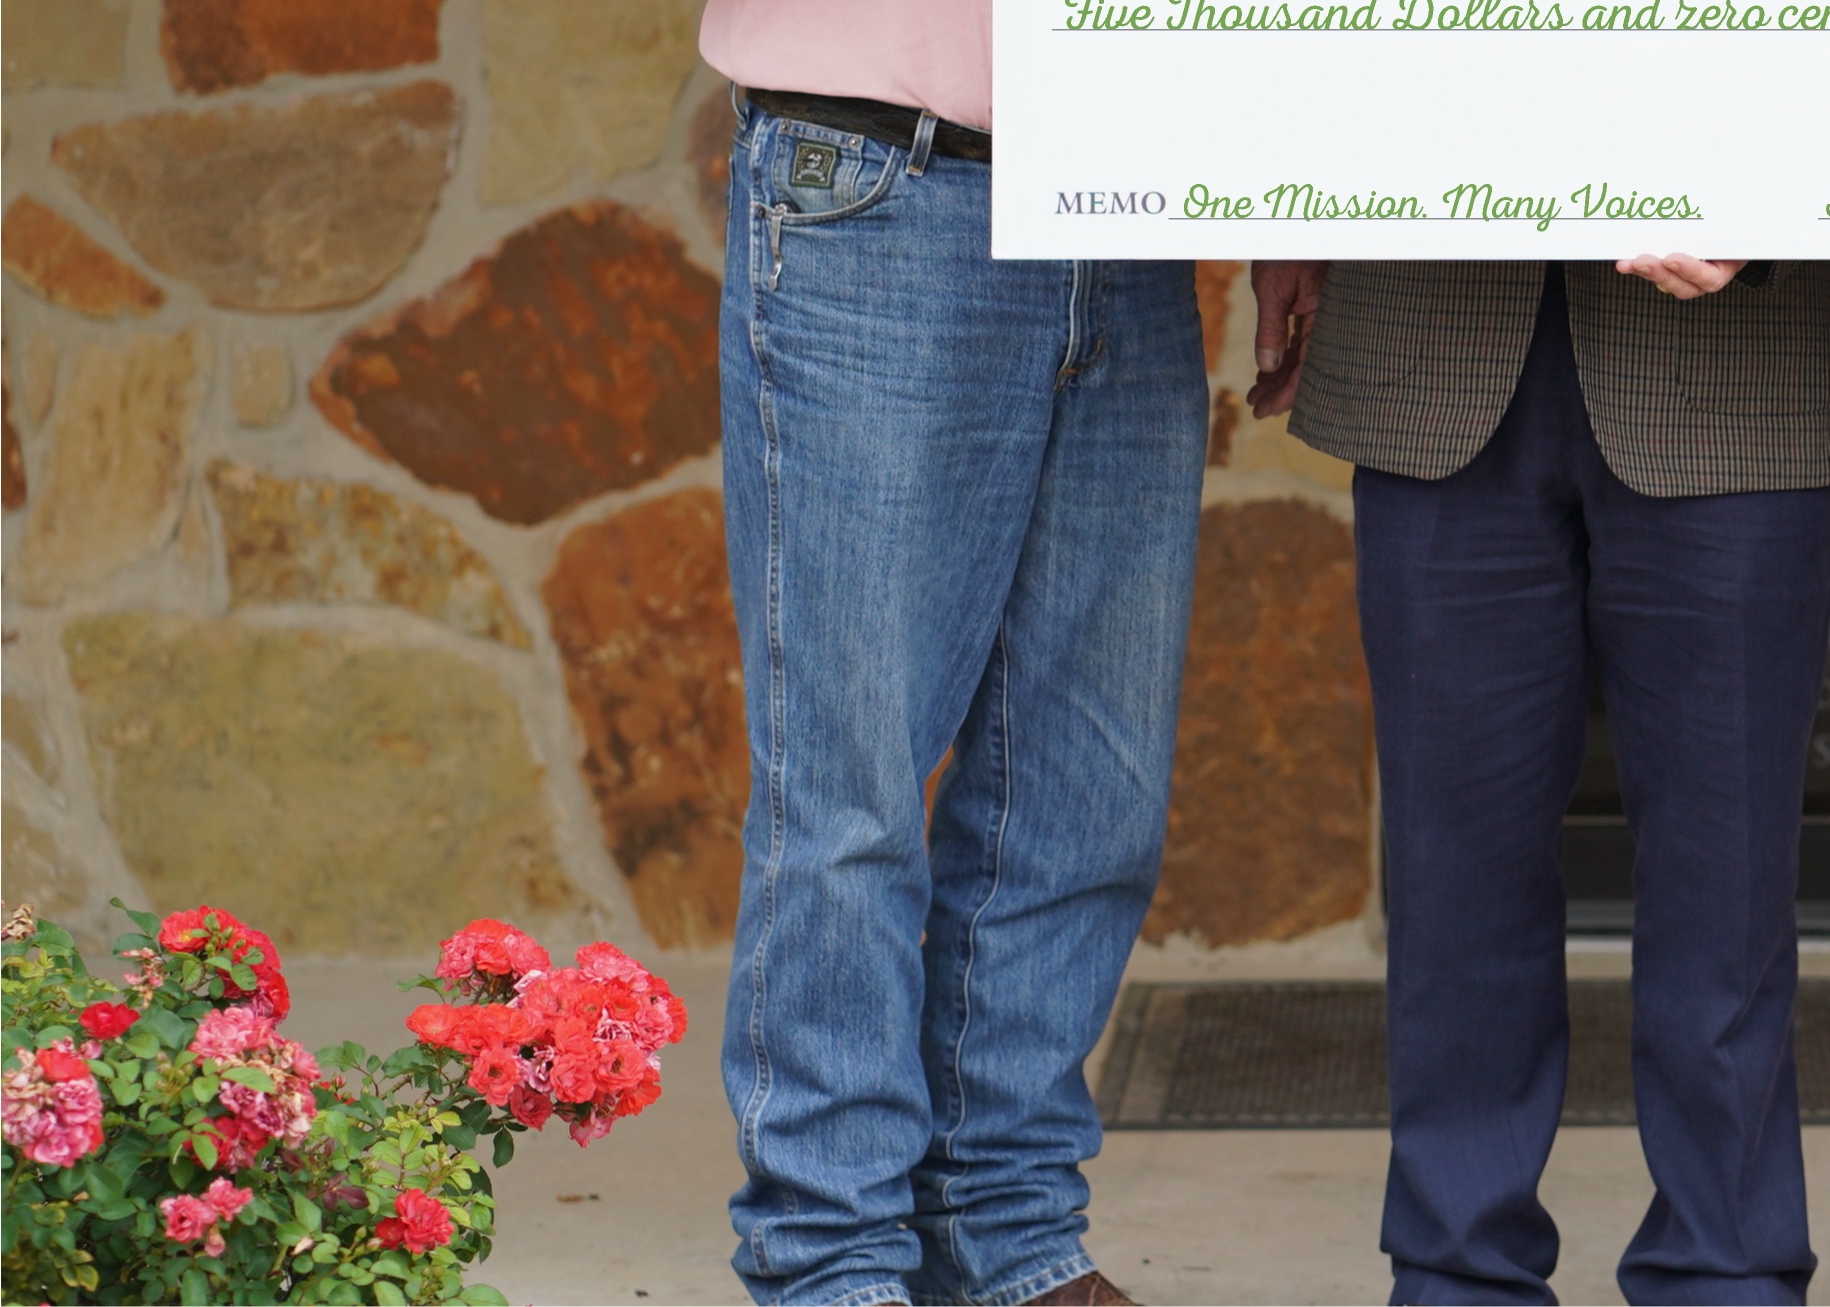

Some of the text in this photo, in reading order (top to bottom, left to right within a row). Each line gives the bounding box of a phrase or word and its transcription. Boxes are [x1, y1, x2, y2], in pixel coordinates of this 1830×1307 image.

[1674, 0, 1772, 30] zero
[1054, 181, 1703, 233] MEMO One Mission. Many Voices.
